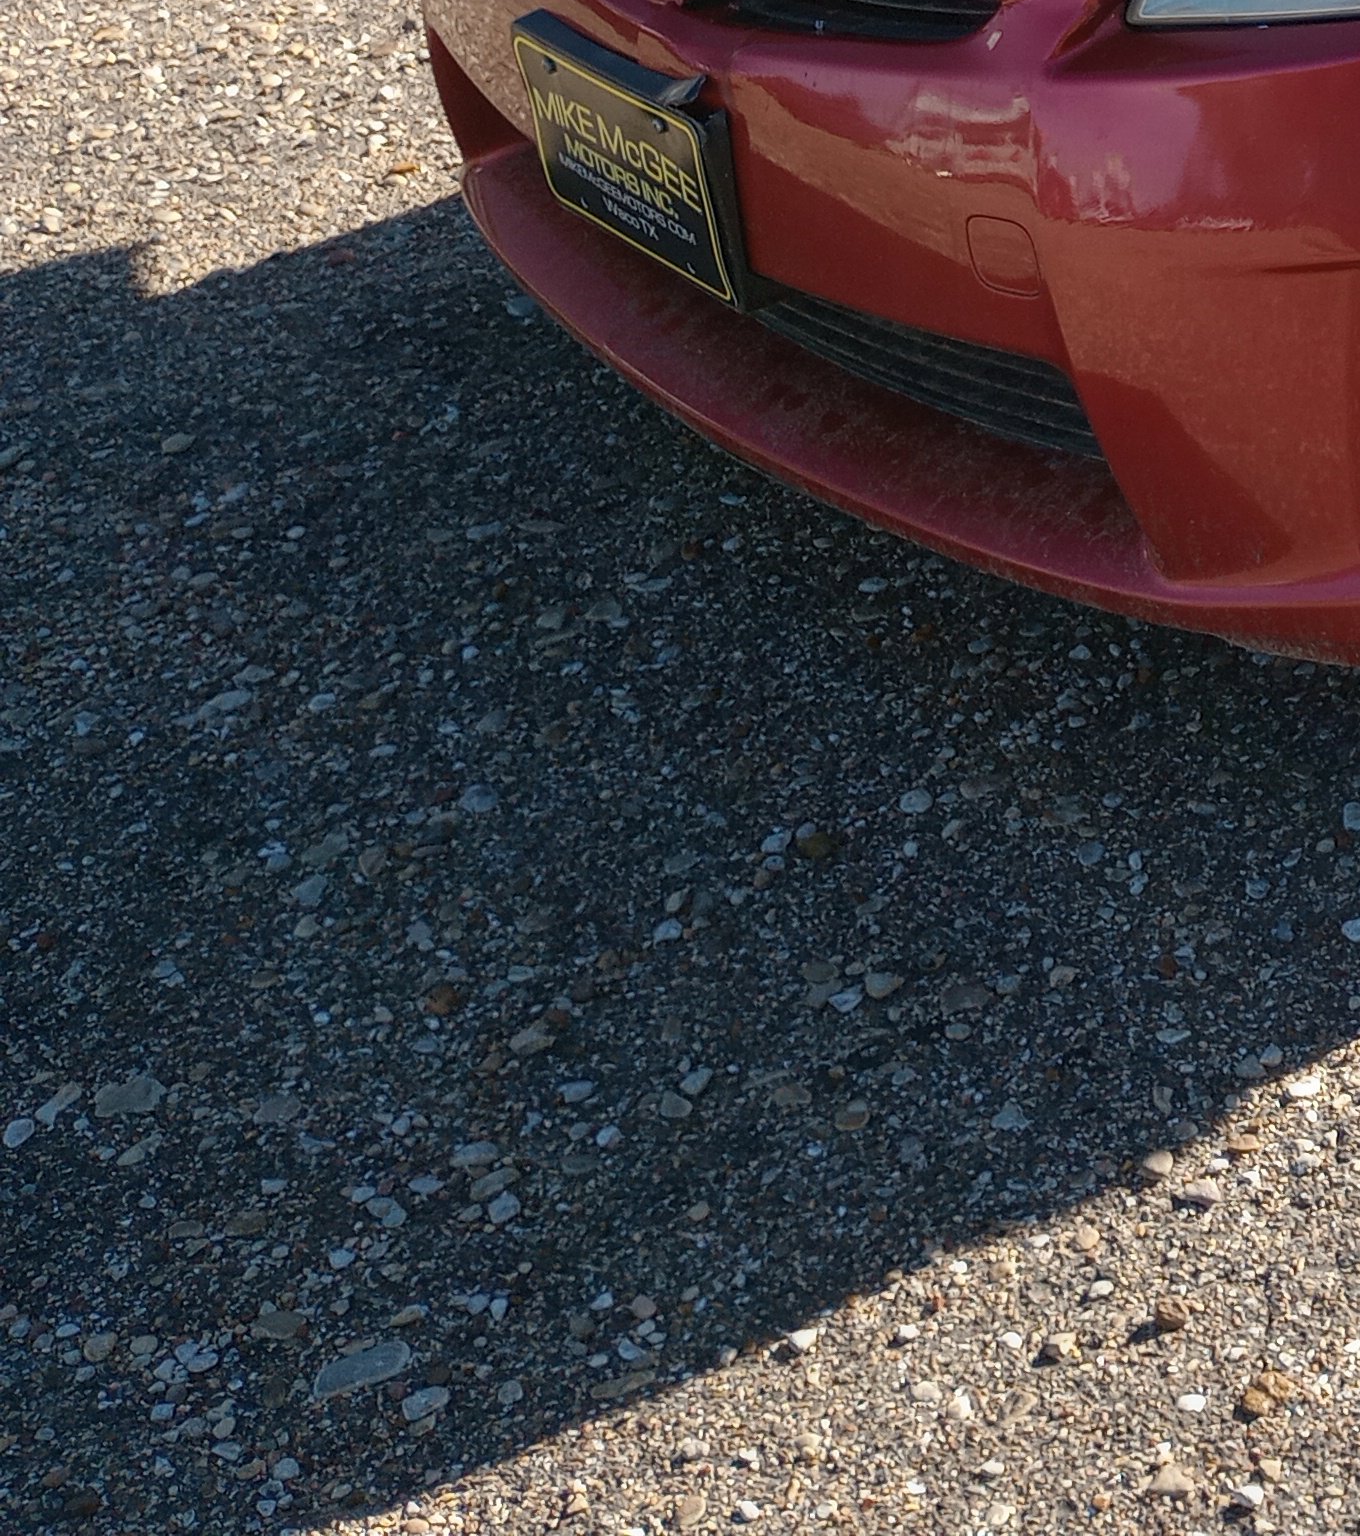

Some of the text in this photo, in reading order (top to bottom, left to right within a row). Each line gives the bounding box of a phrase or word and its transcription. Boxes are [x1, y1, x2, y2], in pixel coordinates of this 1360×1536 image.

[532, 86, 703, 215] MIKE McGEE
[563, 132, 641, 197] MOTORS
[602, 194, 660, 242] Waco TX
